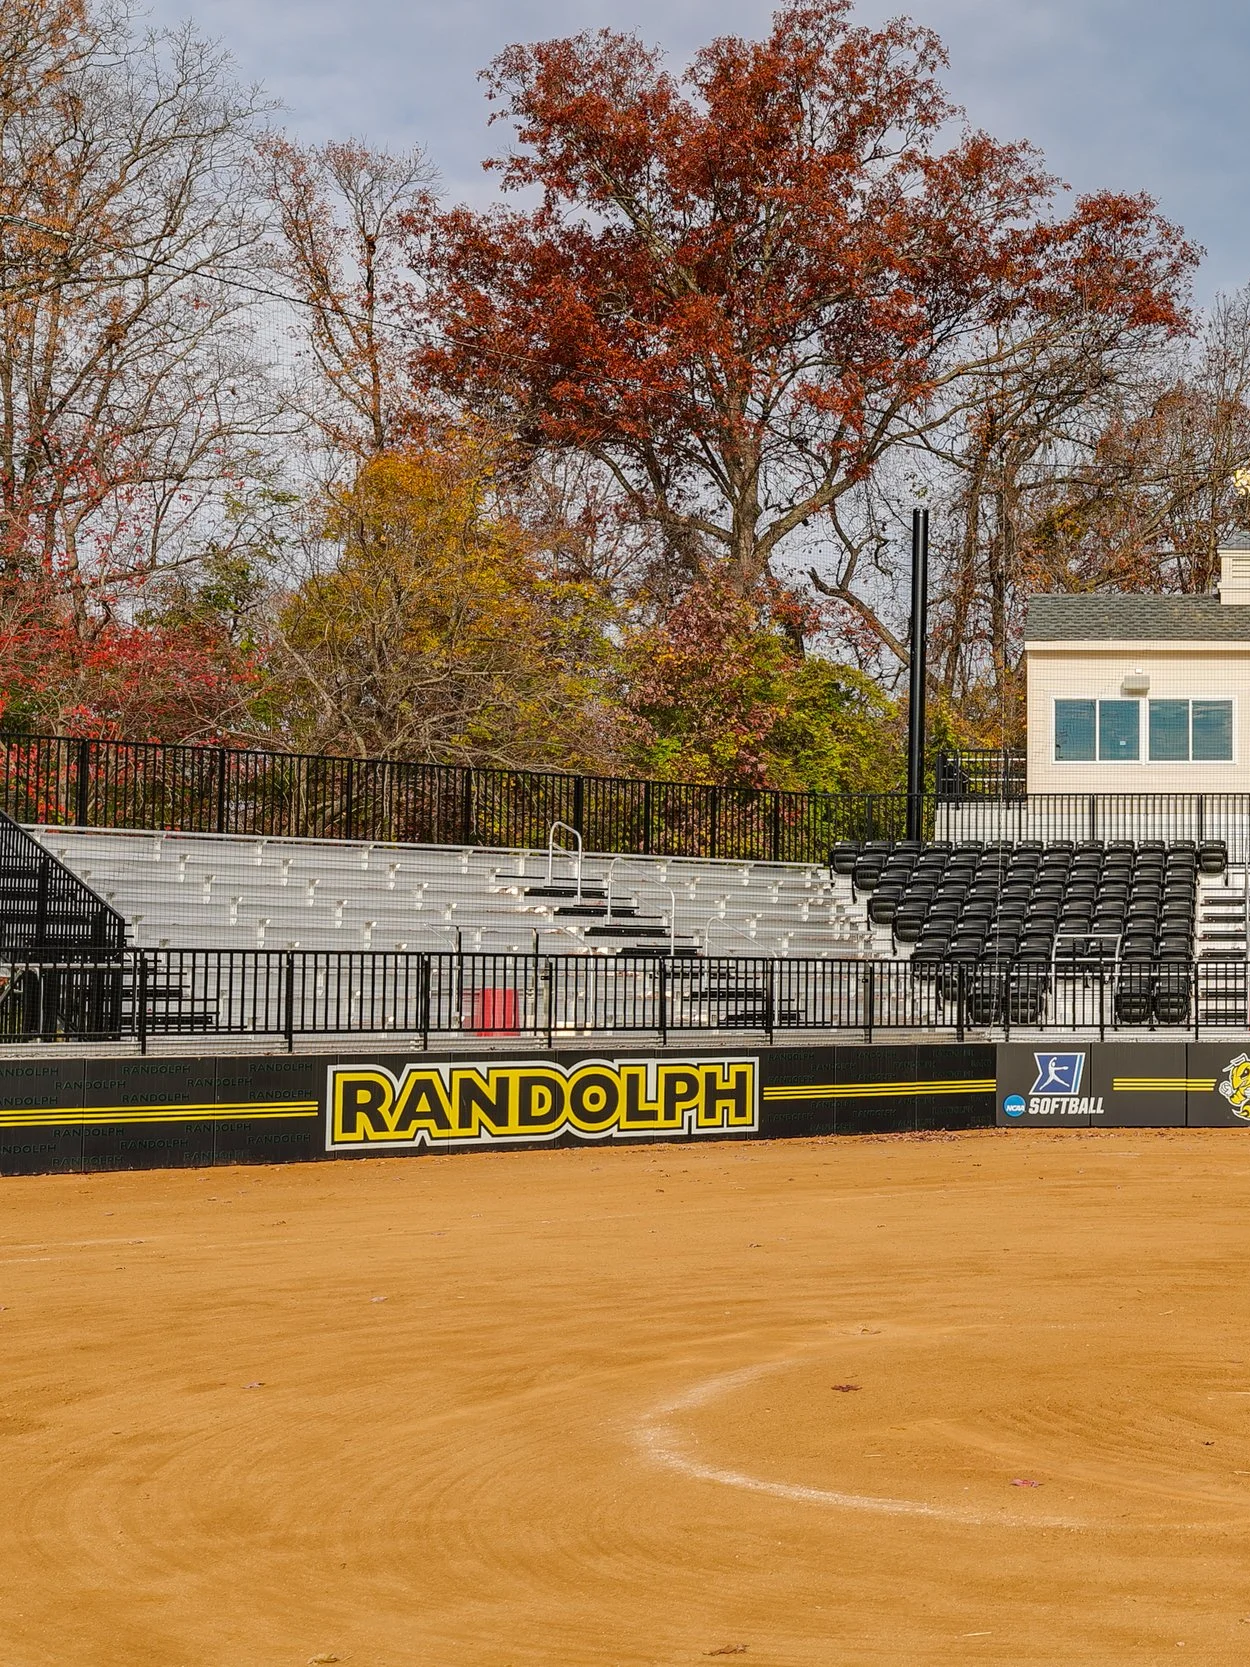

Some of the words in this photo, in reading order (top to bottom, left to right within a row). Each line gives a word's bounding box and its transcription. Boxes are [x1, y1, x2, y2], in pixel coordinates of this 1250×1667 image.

[122, 1064, 191, 1076] RANDOLPH
[249, 1063, 313, 1072] RANDOLPH
[55, 1080, 126, 1090] RANDOLPH
[187, 1078, 253, 1088] RANDOLPH
[121, 1093, 190, 1104] RANDOLPH
[249, 1090, 312, 1100] RANDOLPH
[330, 1060, 757, 1147] RANDOLPH
[1006, 1104, 1025, 1112] NCAA
[1028, 1097, 1104, 1114] SOFTBALL
[53, 1127, 125, 1137] RANDOLPH
[185, 1123, 252, 1133] RANDOLPH
[120, 1138, 189, 1150] RANDOLPH
[247, 1134, 311, 1145] RANDOLPH
[52, 1155, 124, 1167] RANDOLPH
